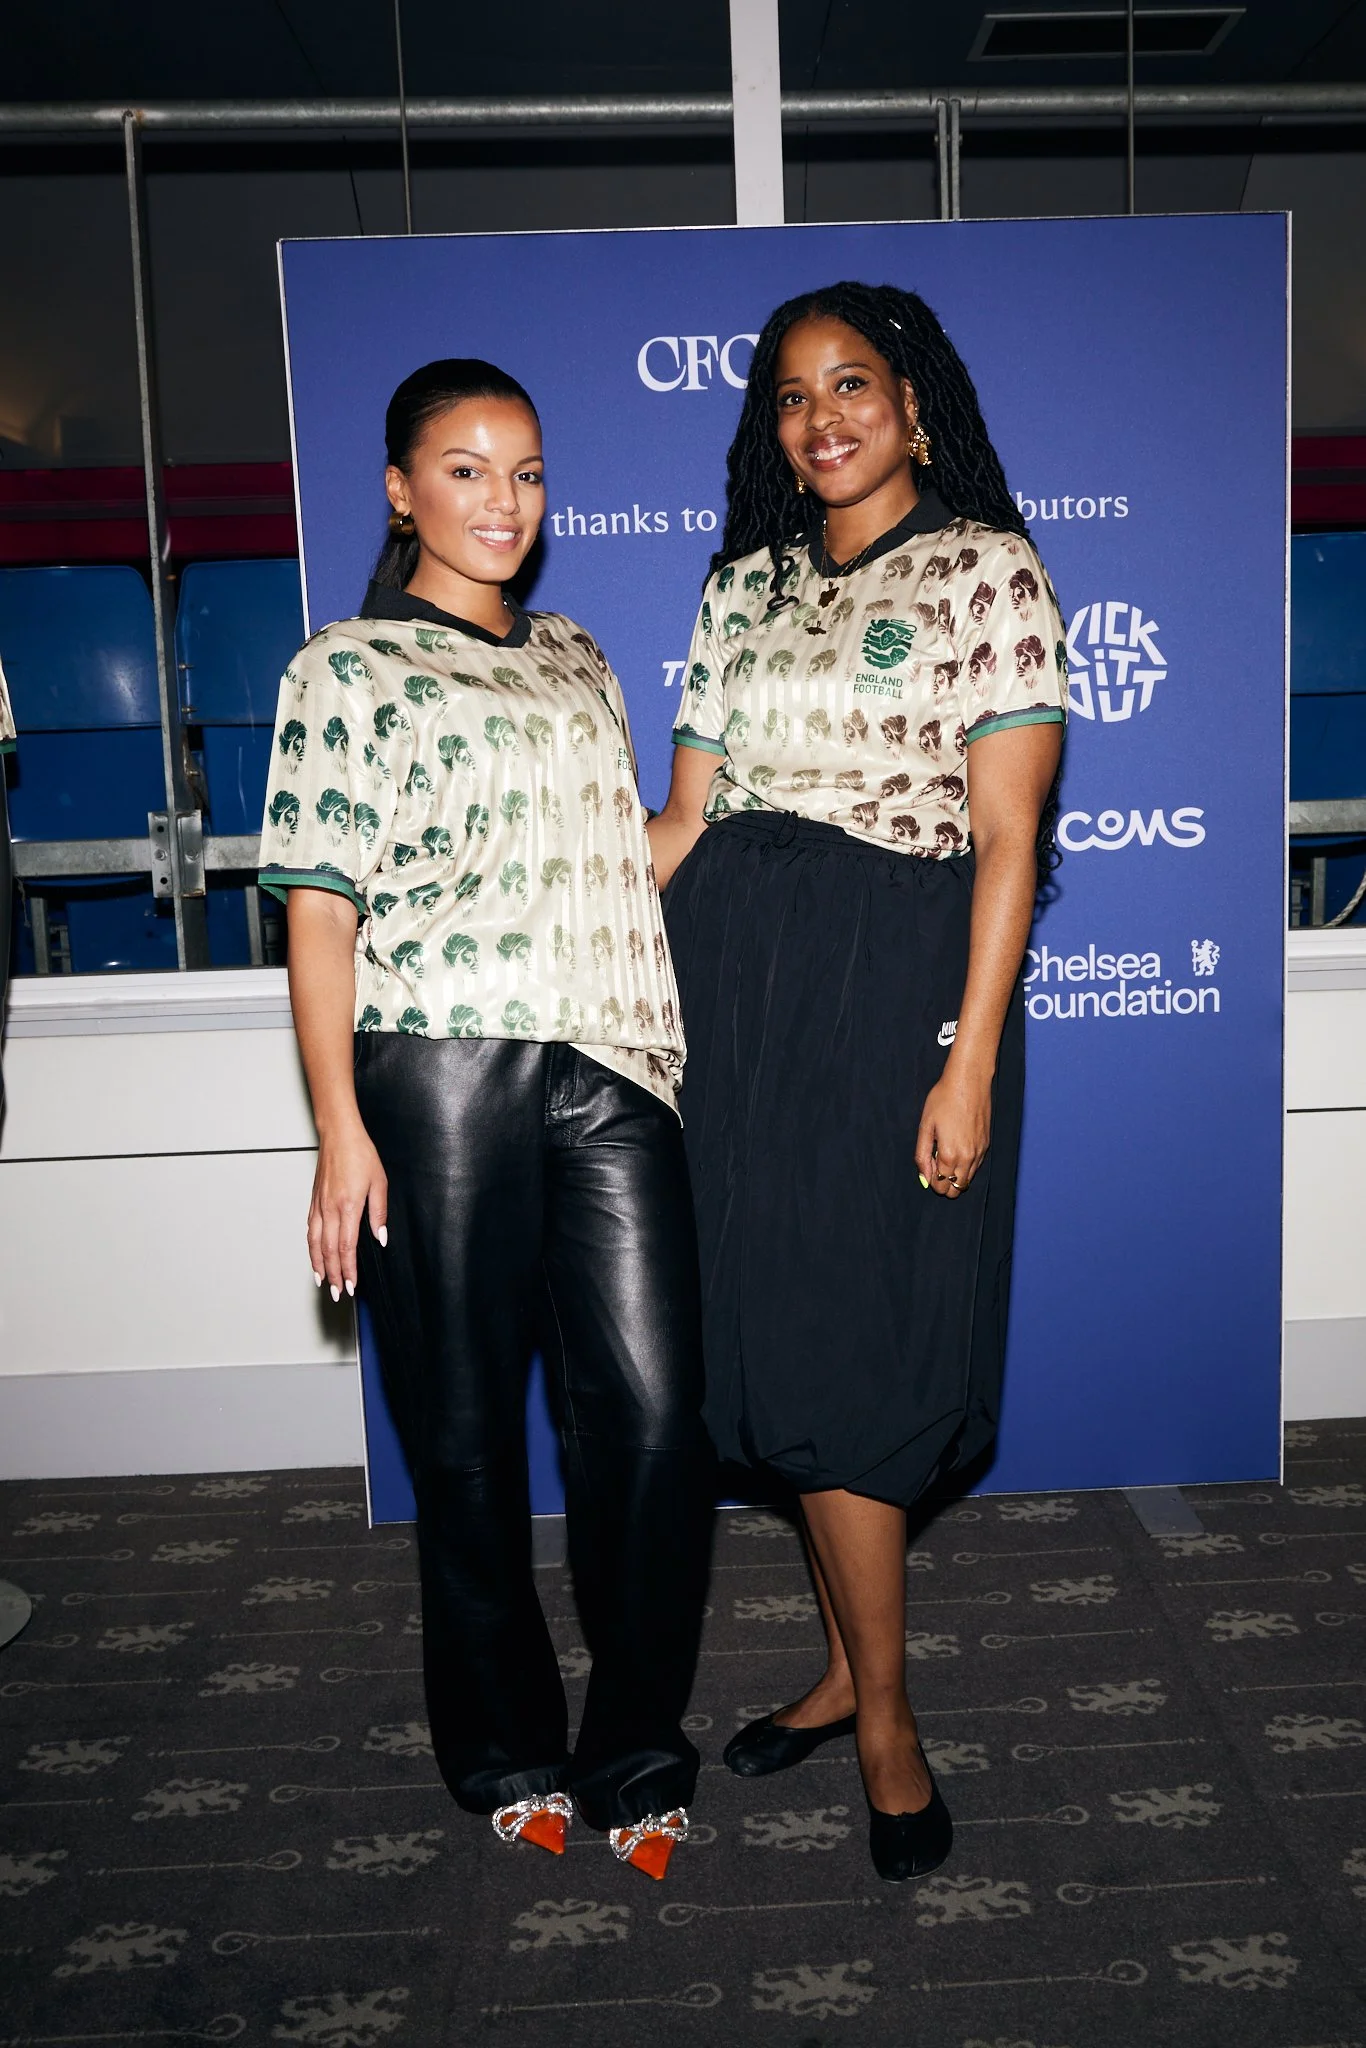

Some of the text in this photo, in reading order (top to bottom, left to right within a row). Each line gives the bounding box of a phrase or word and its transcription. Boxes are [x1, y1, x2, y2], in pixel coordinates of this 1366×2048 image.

[551, 491, 1129, 536] thanks to butors
[855, 673, 903, 688] ENGLAND
[853, 683, 903, 699] FOOTBALL
[1024, 979, 1220, 1020] oundation
[941, 1020, 958, 1036] NIK
